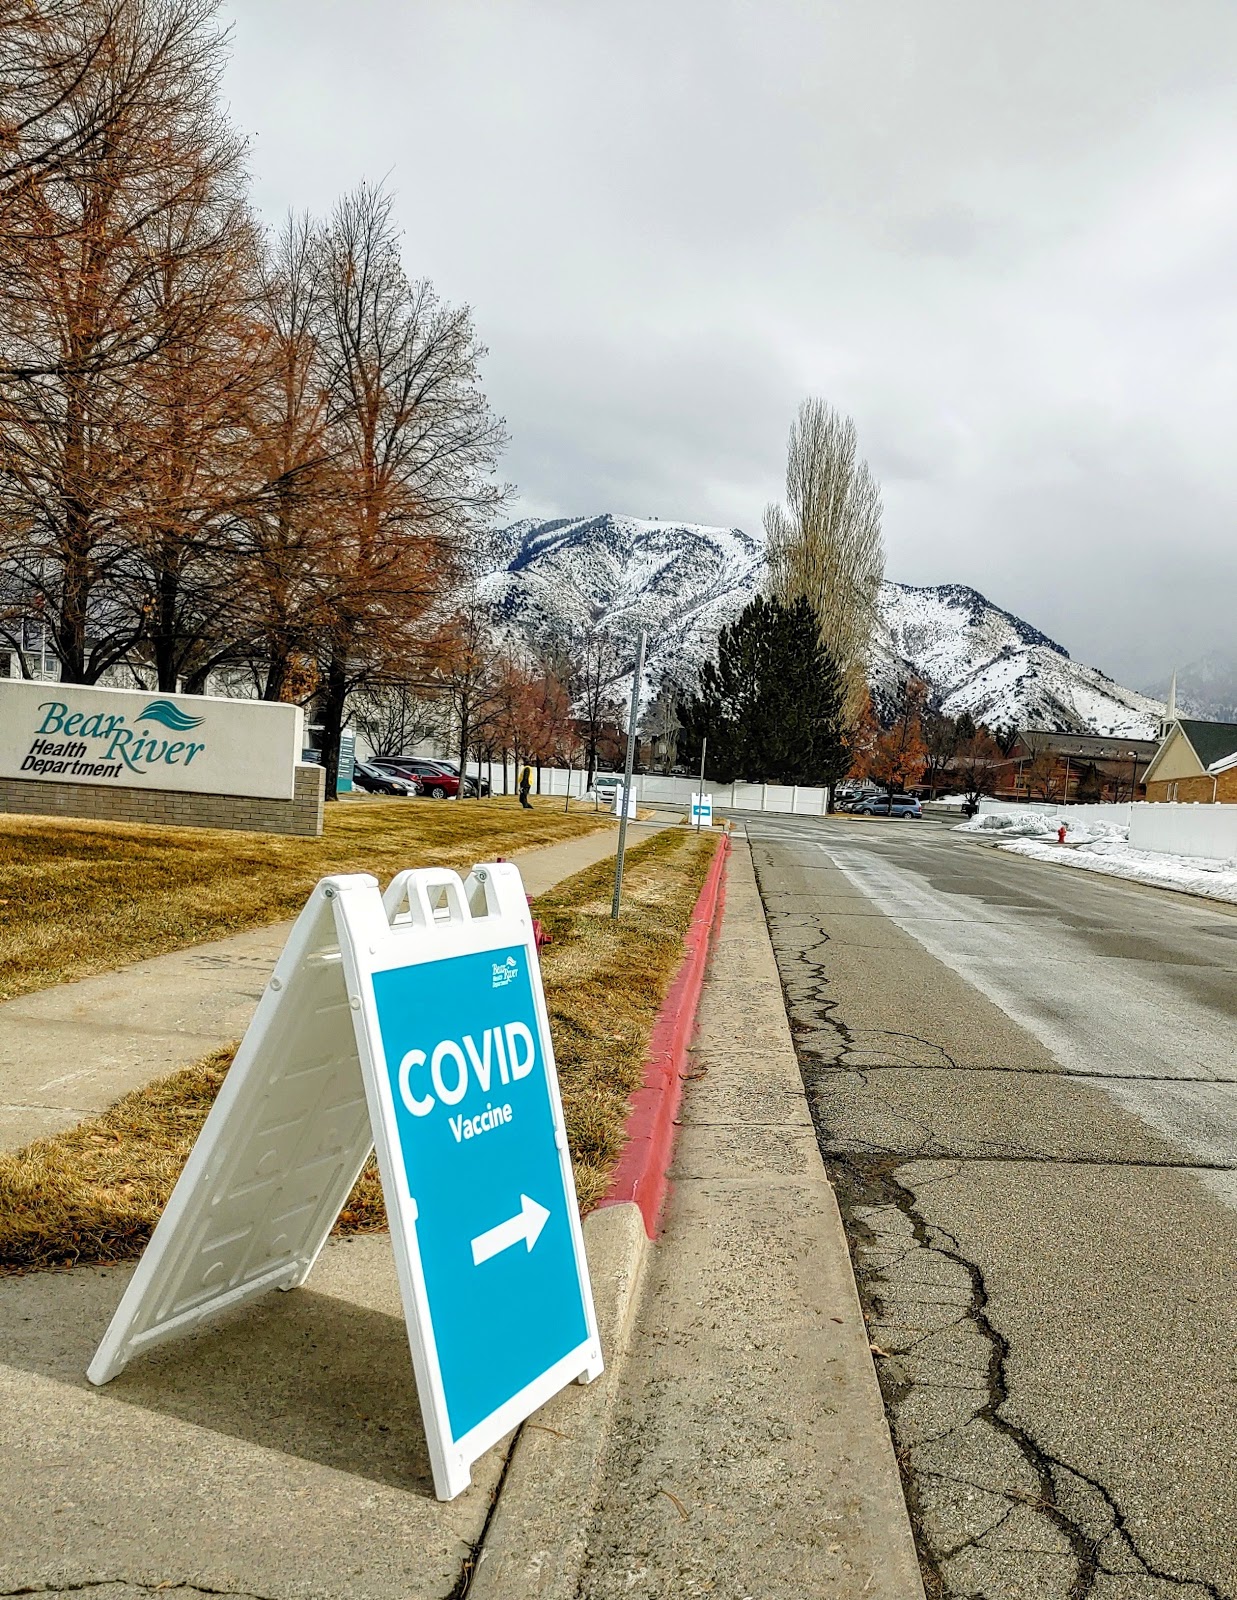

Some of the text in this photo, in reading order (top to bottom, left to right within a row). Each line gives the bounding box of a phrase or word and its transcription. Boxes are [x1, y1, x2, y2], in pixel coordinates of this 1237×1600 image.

[29, 739, 87, 758] Health
[35, 702, 205, 774] Bear River
[20, 756, 123, 778] Department
[399, 1021, 535, 1117] COVID
[448, 1103, 513, 1143] Vaccine
